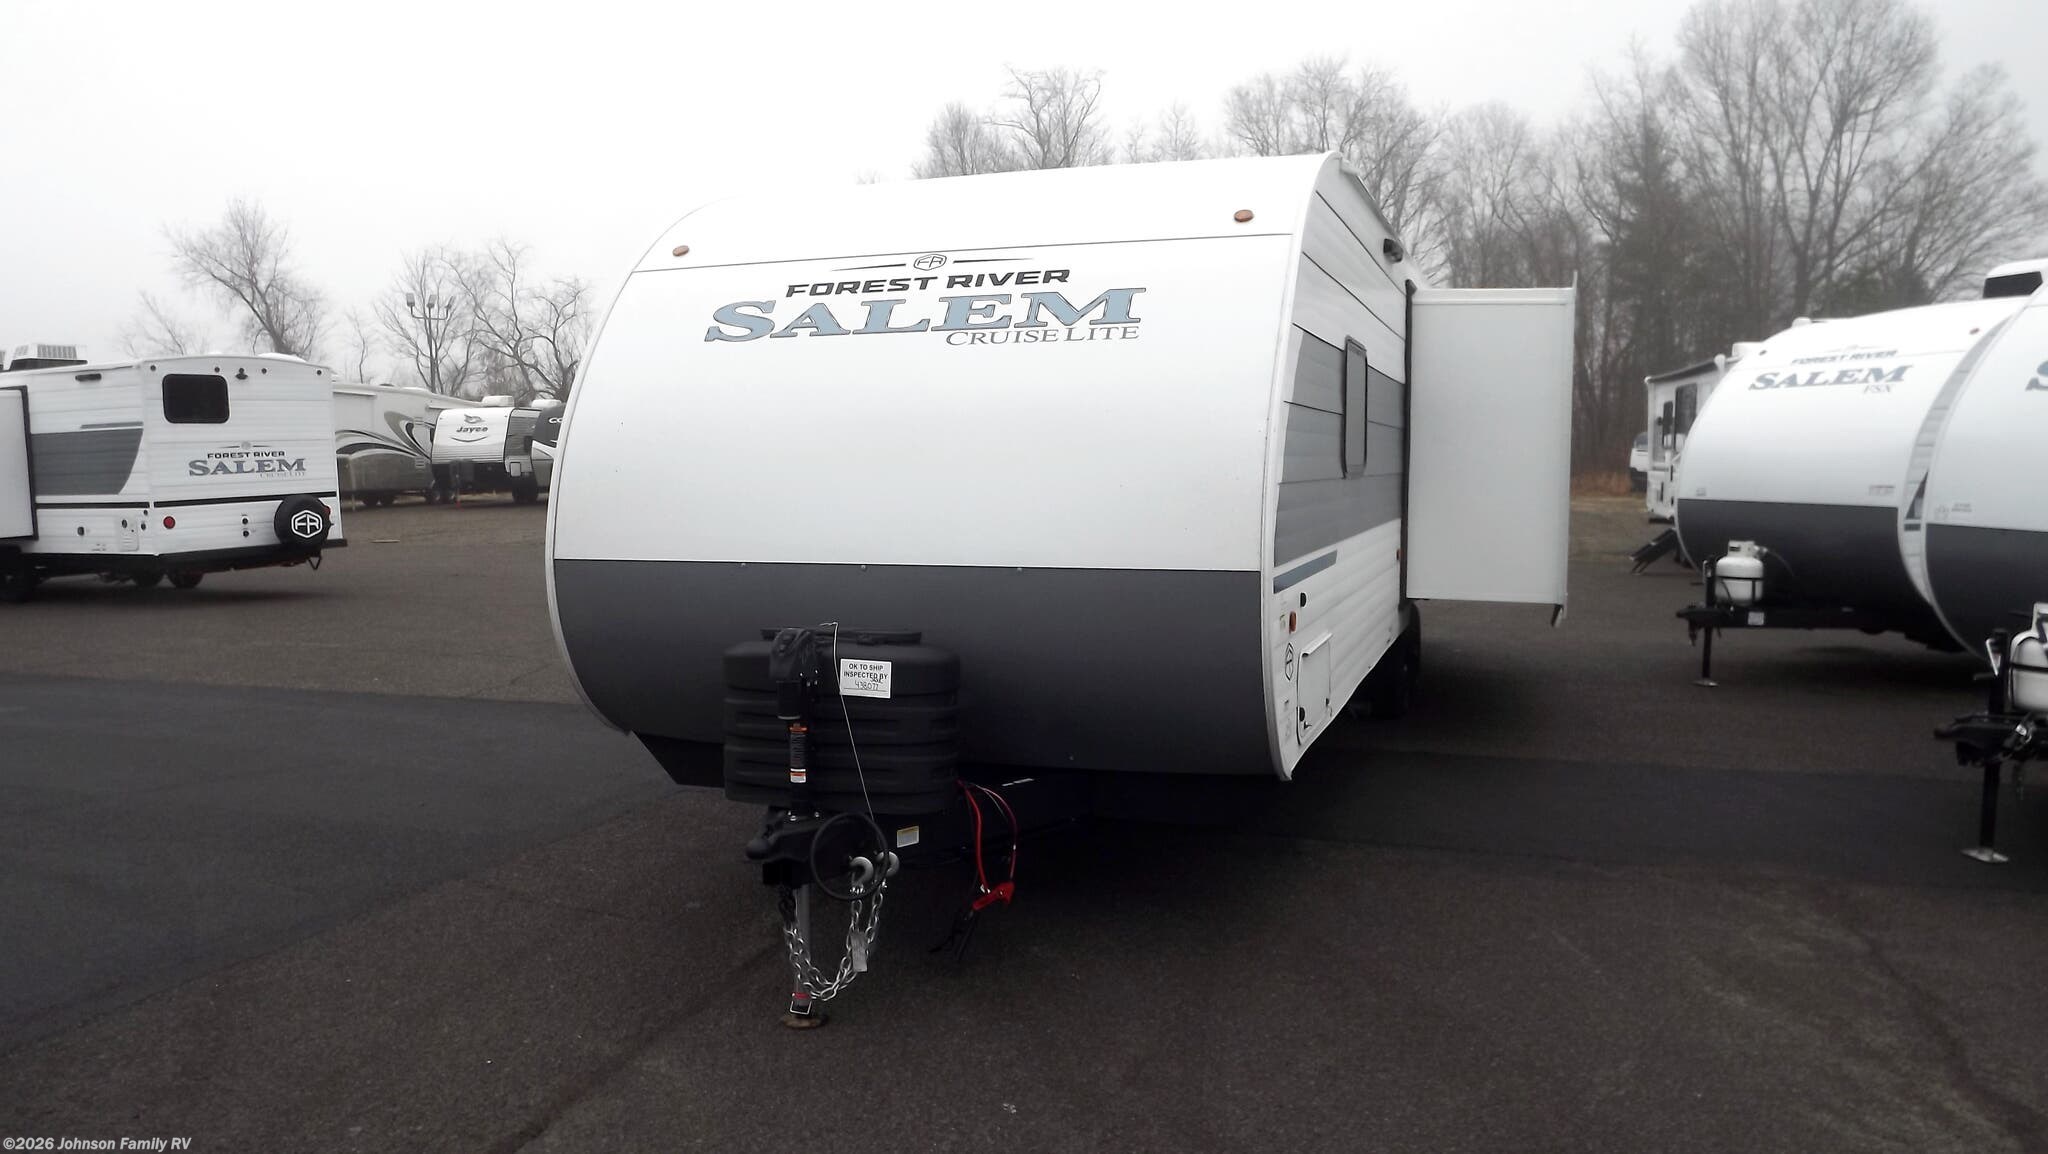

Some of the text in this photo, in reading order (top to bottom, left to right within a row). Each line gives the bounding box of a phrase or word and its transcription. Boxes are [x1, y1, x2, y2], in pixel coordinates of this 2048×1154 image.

[786, 269, 1070, 297] FOREST RIVER
[704, 287, 1147, 342] SALEM
[1791, 349, 1898, 365] FOREST RIVER
[1748, 365, 1914, 391] SALEM
[456, 426, 489, 434] Jayco
[254, 450, 285, 458] RIVER
[188, 458, 307, 476] SALEM
[843, 671, 878, 679] INSPECTED
[860, 663, 868, 671] TO
